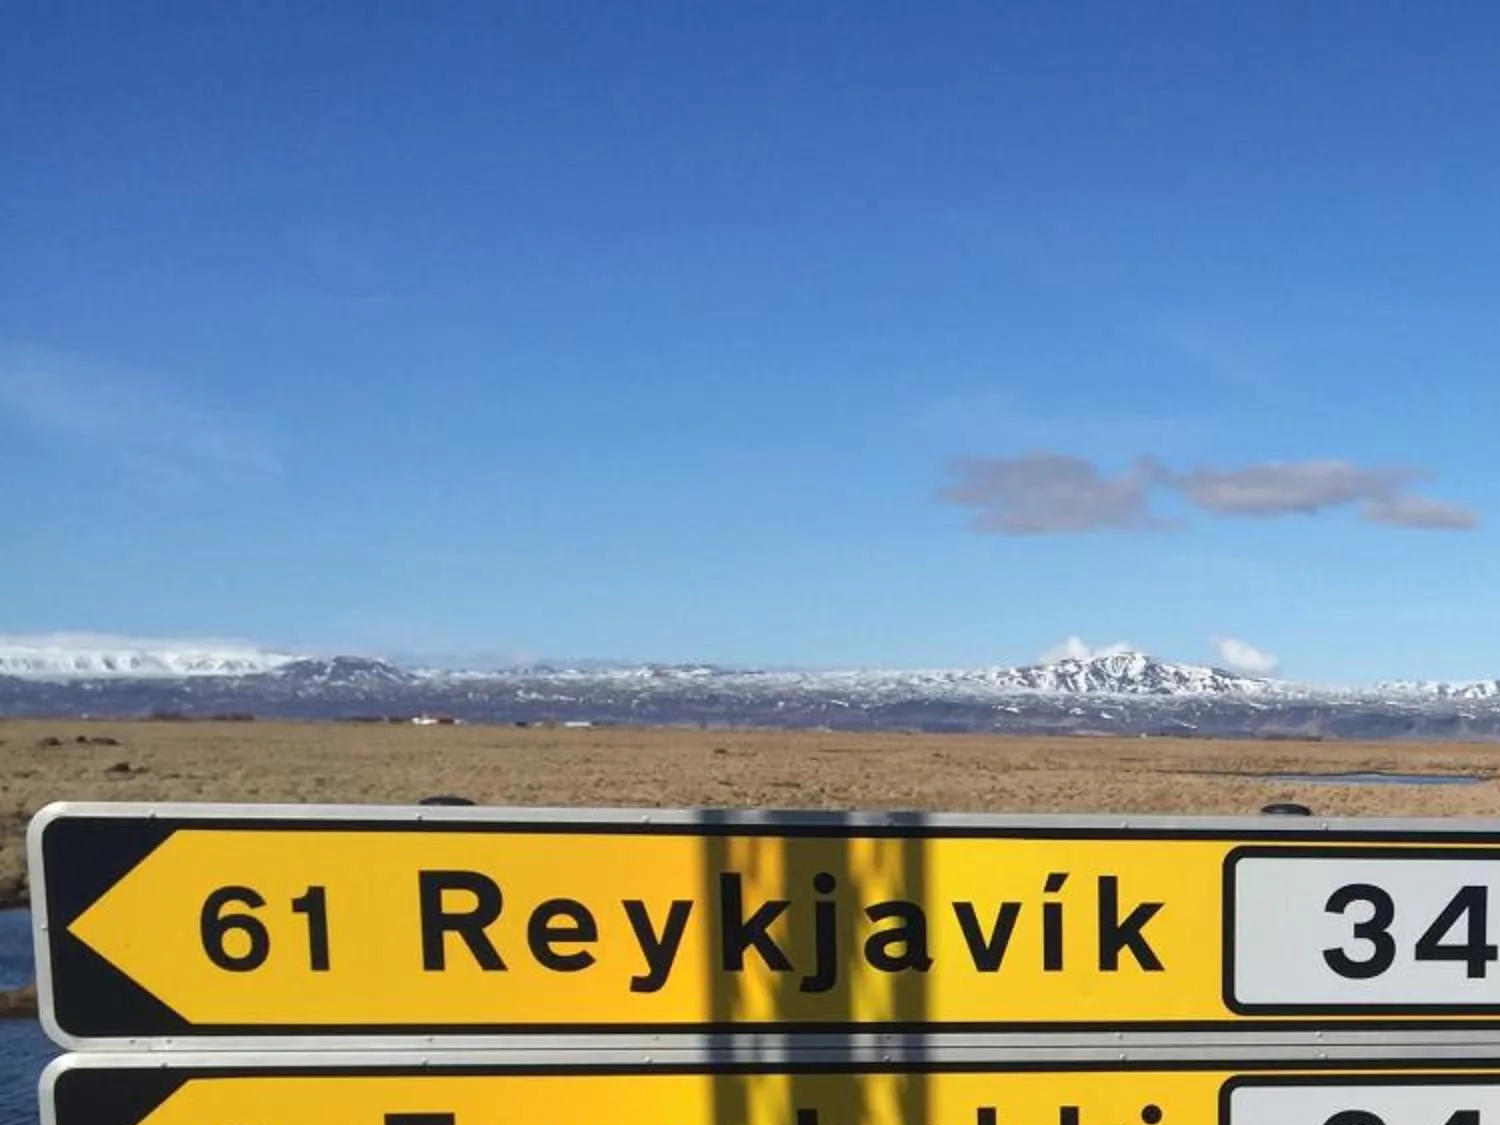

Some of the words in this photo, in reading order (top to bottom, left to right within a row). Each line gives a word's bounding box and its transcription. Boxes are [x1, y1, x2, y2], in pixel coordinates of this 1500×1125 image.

[199, 884, 331, 973] 61
[418, 869, 1166, 994] Reykjavík
[1322, 883, 1499, 979] 34
